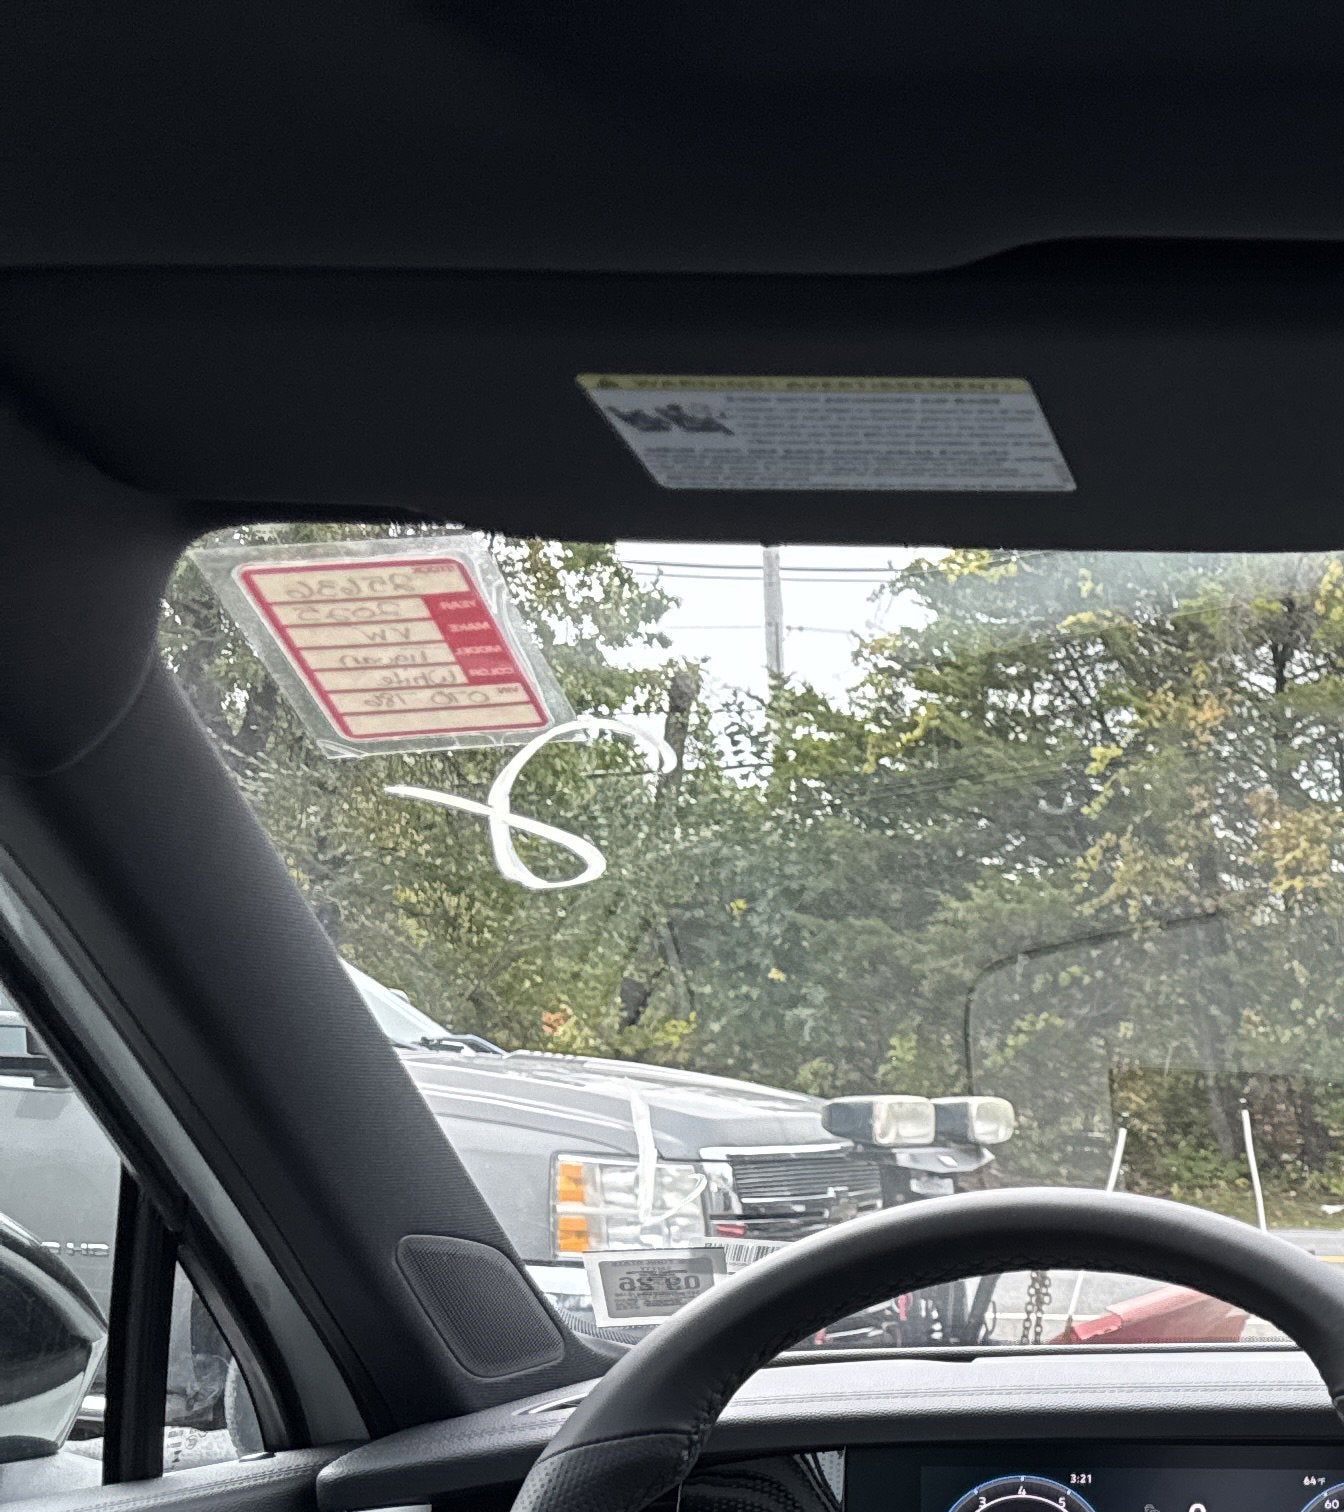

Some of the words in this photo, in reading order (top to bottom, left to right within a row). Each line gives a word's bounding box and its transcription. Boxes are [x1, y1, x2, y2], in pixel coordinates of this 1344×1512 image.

[1070, 1473, 1092, 1484] 3:21
[1018, 1486, 1026, 1496] 4
[978, 1496, 987, 1507] 3
[1058, 1497, 1066, 1508] 5
[1324, 1500, 1340, 1509] 60
